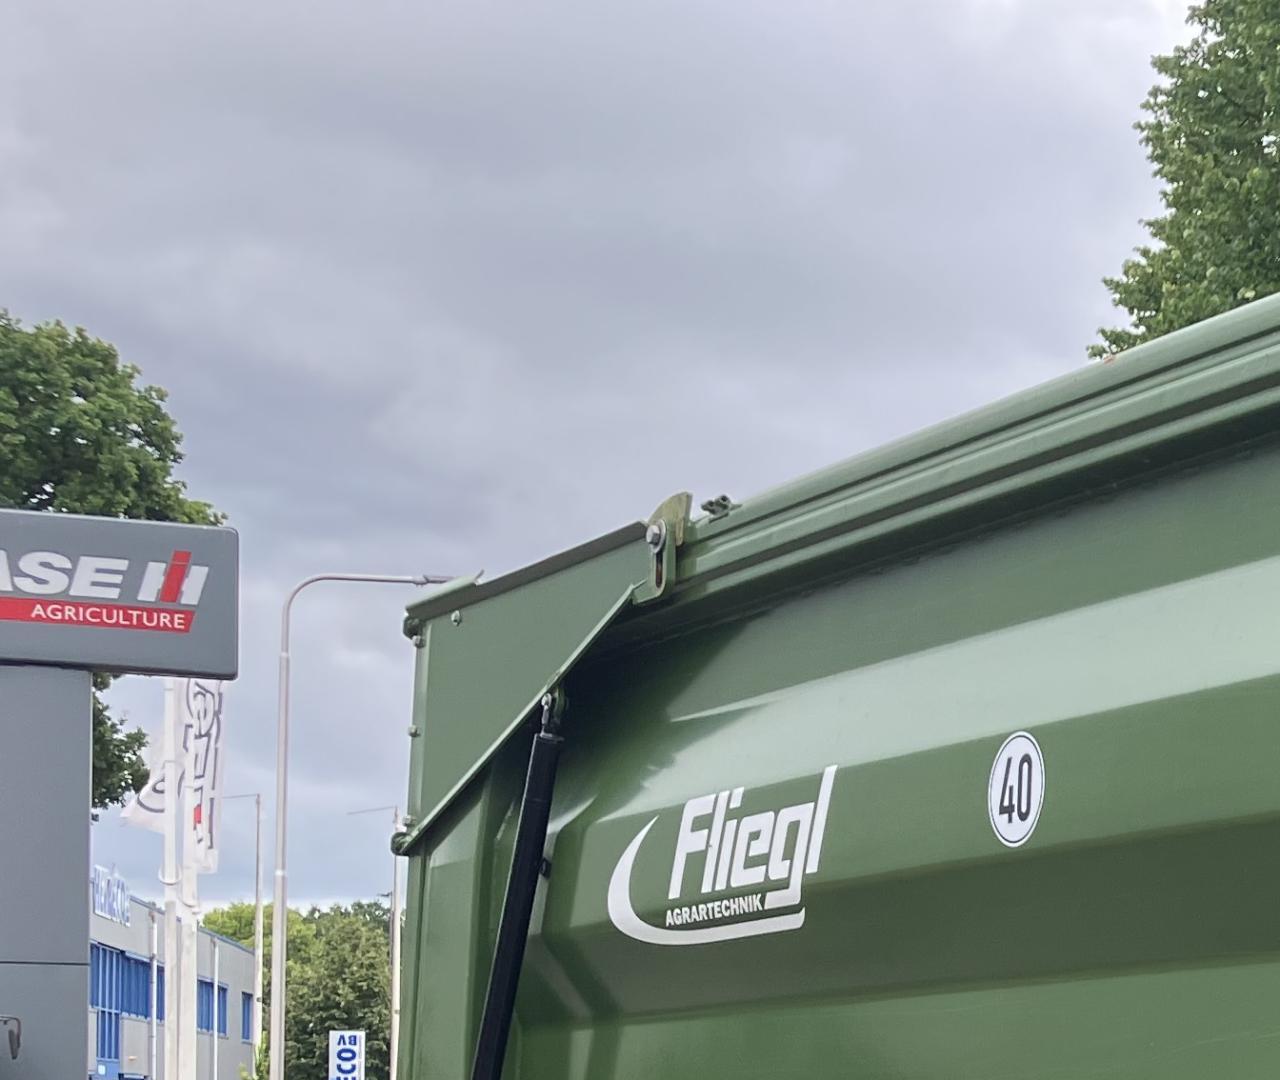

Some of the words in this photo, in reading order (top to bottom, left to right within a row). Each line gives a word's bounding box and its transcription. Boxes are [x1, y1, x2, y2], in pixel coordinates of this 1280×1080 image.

[31, 603, 185, 629] AGRICULTURE
[998, 752, 1033, 824] 40
[668, 765, 838, 910] Fliegl
[665, 894, 764, 927] AGRARTECHNIK
[337, 1034, 357, 1046] BV
